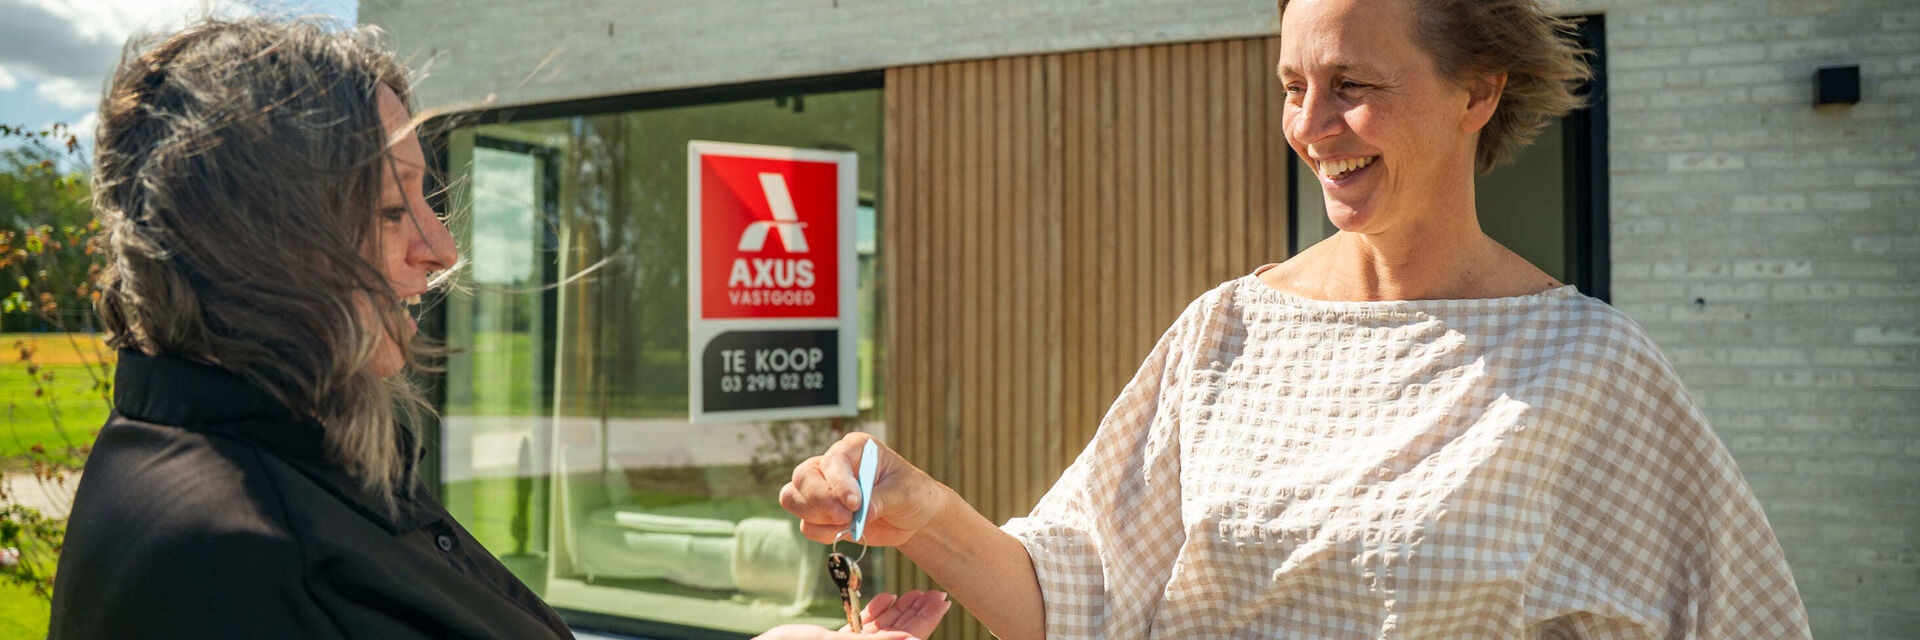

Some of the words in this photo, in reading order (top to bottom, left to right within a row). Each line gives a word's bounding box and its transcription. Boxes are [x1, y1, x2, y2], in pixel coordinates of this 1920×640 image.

[728, 258, 816, 288] AXUS
[729, 290, 816, 306] VASTGOED
[721, 349, 746, 373] TE
[755, 347, 824, 372] KOOP
[721, 375, 742, 392] 03
[747, 374, 776, 392] 298
[780, 373, 800, 390] 02
[804, 372, 824, 389] 02
